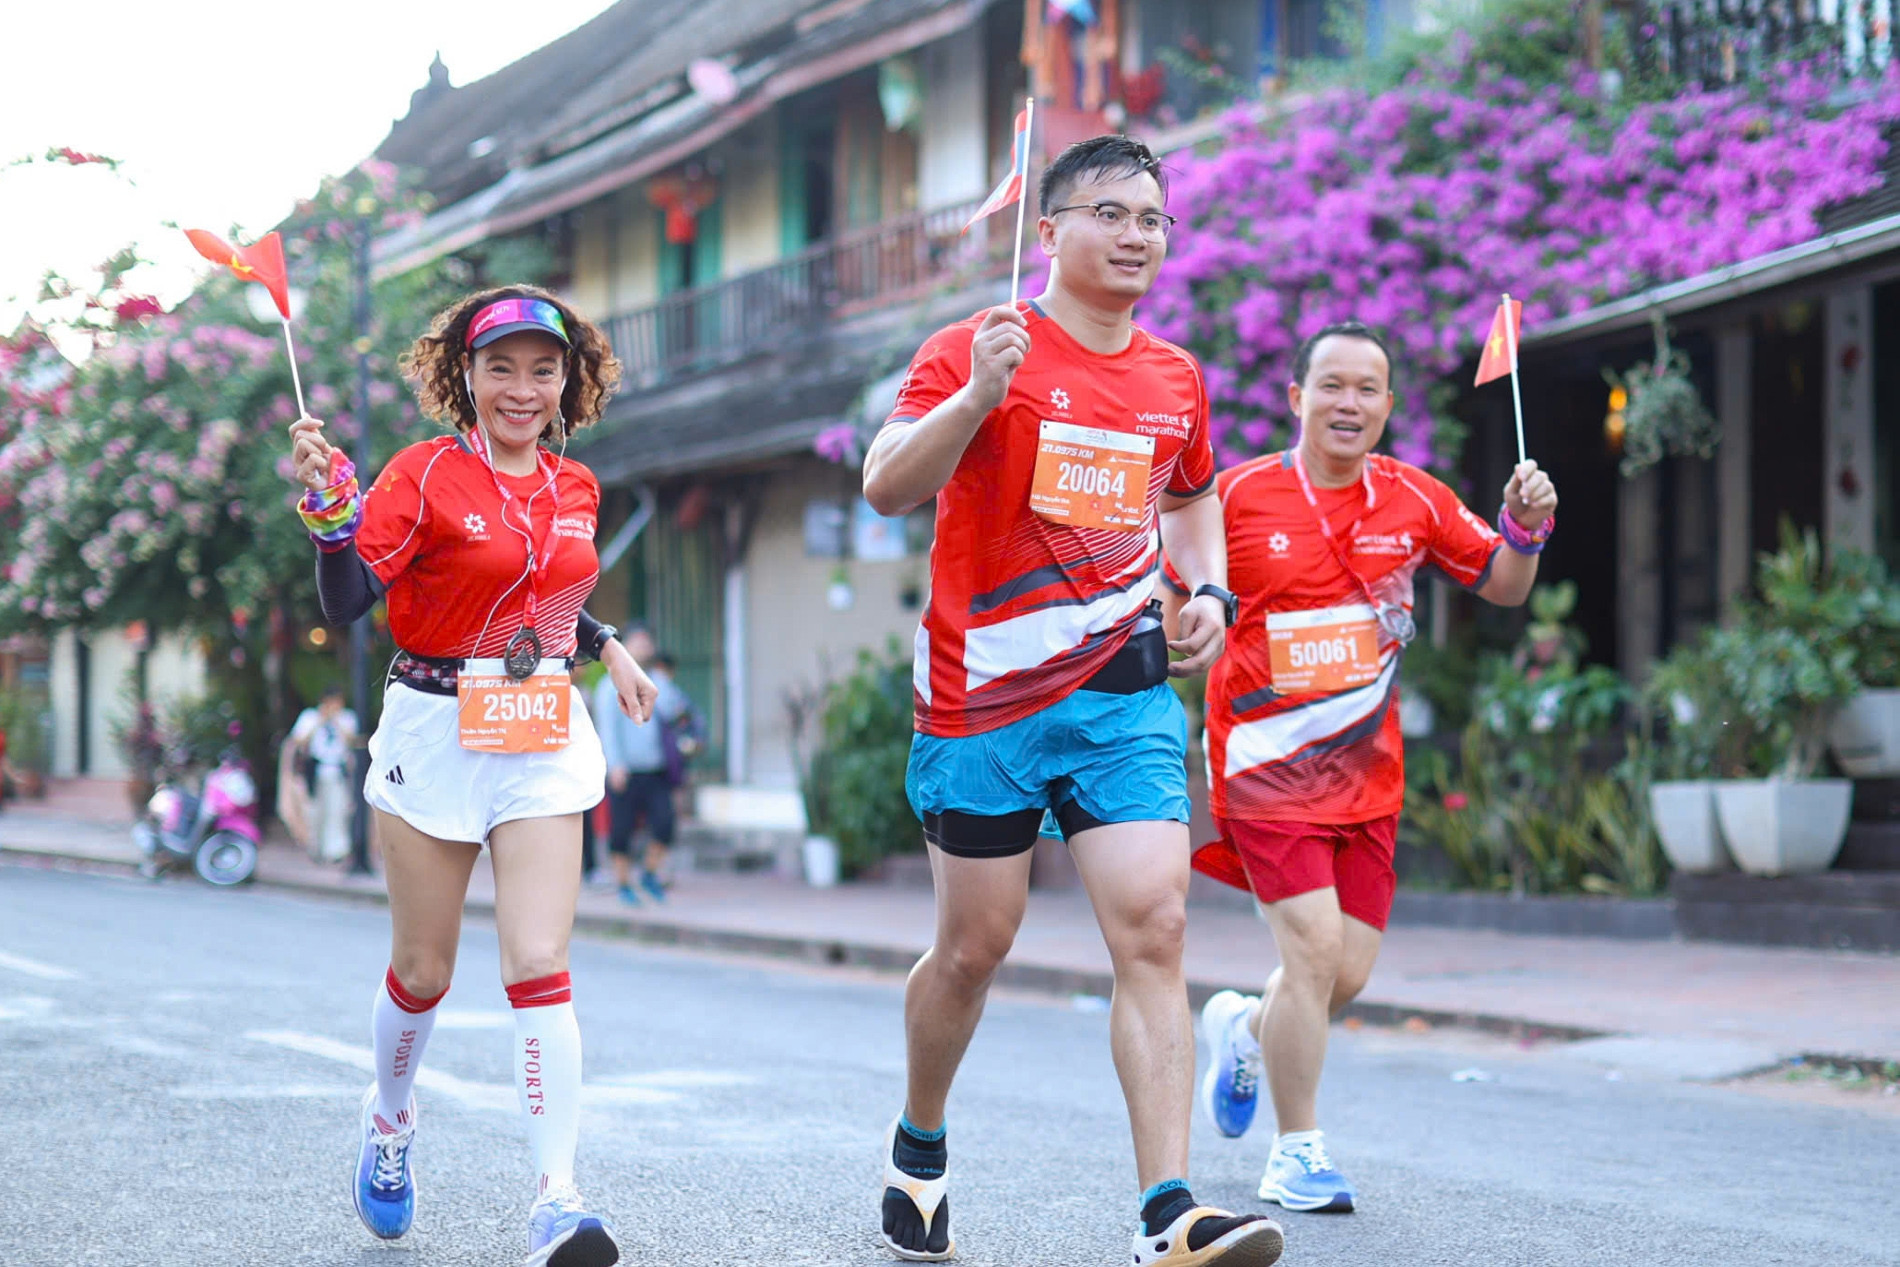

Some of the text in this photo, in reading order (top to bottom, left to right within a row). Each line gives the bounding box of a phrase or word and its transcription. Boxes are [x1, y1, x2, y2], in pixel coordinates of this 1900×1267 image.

[1135, 411, 1180, 426] viettel
[1135, 424, 1185, 439] marathon
[1041, 443, 1095, 460] 21.0975 KM
[1057, 461, 1126, 498] 20064
[1289, 636, 1357, 668] 50061
[483, 692, 558, 722] 25042
[393, 1029, 417, 1078] SPORTS
[524, 1037, 545, 1116] SPORTS
